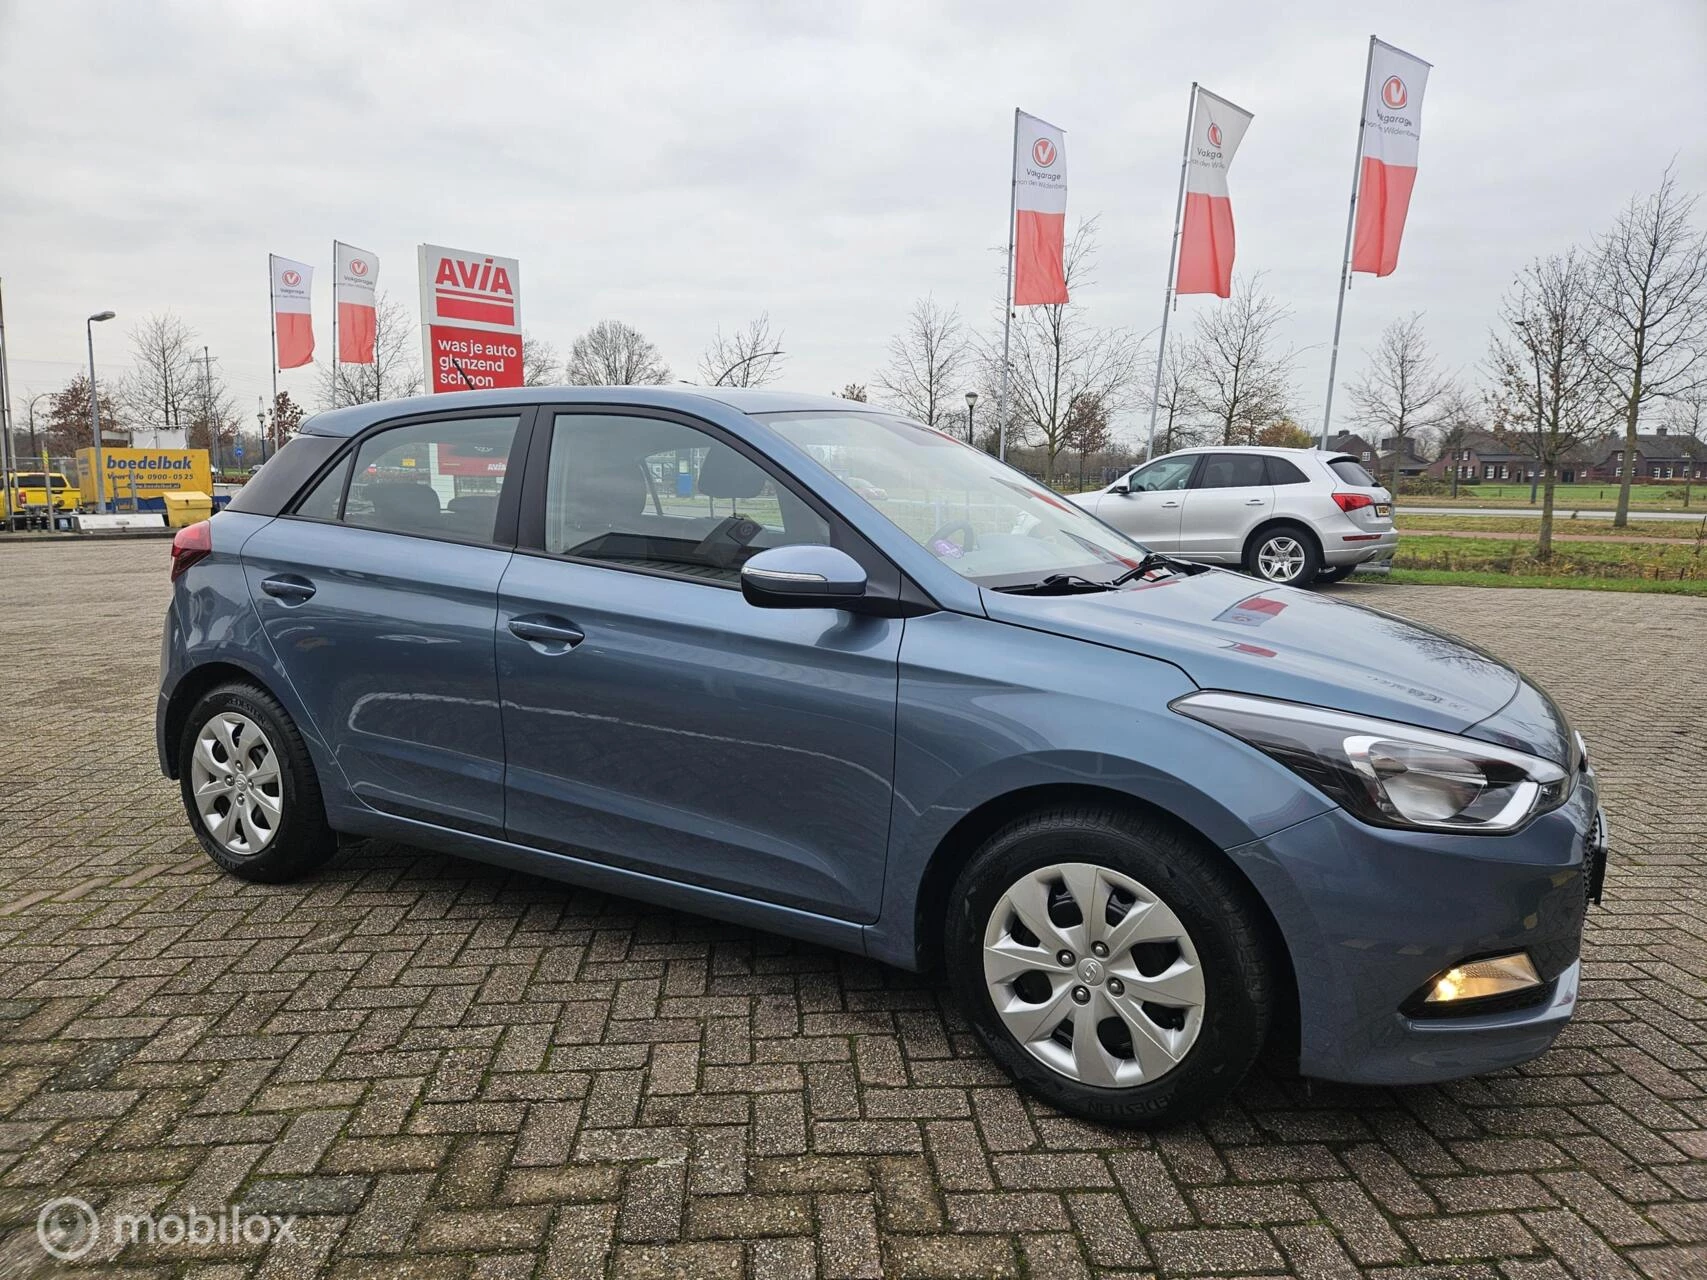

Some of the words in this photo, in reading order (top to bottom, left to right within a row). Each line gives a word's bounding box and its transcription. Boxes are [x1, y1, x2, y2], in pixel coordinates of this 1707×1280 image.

[438, 339, 468, 353] was
[469, 340, 483, 356] je
[486, 344, 517, 358] auto
[439, 354, 505, 372] glanzend
[440, 371, 494, 387] schoon
[106, 455, 192, 470] boedelbak
